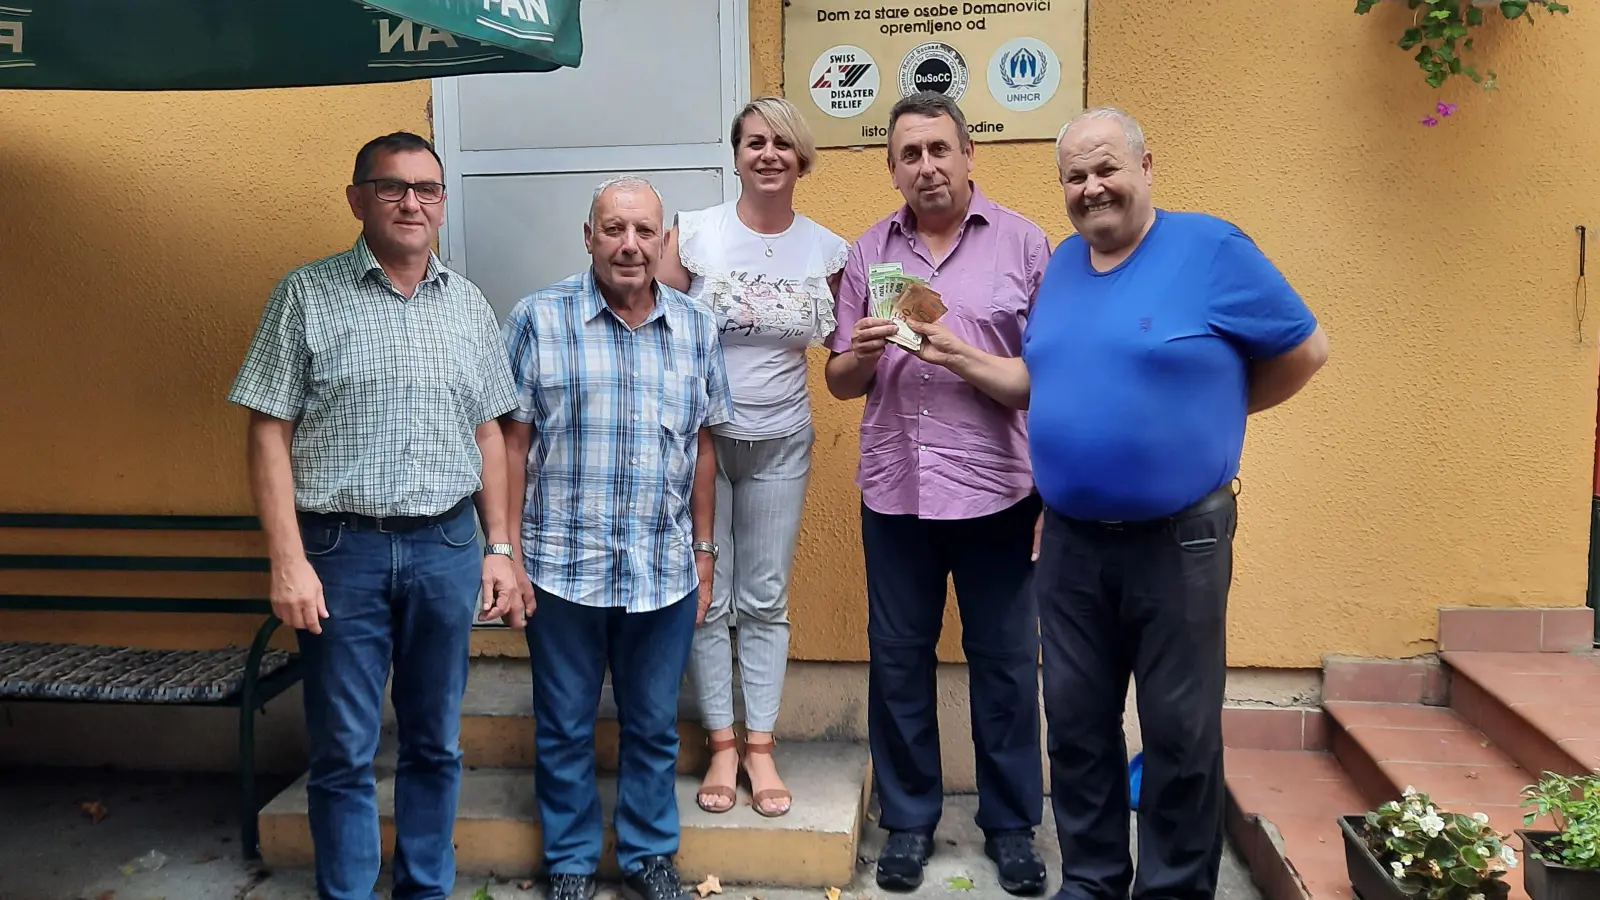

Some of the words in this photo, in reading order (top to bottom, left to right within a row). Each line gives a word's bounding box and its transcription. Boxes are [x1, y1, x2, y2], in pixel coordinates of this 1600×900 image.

[817, 9, 850, 22] Dom
[854, 10, 870, 20] za
[874, 7, 910, 20] stare
[913, 4, 958, 17] osobe
[880, 19, 962, 36] opremljeno
[966, 17, 986, 30] od
[830, 54, 855, 64] SWISS
[915, 73, 951, 83] DuSoCC
[830, 89, 874, 99] DISASTER
[1006, 93, 1041, 102] UNHCR
[831, 100, 862, 109] RELIEF
[861, 125, 888, 137] listo
[967, 121, 1004, 134] odine
